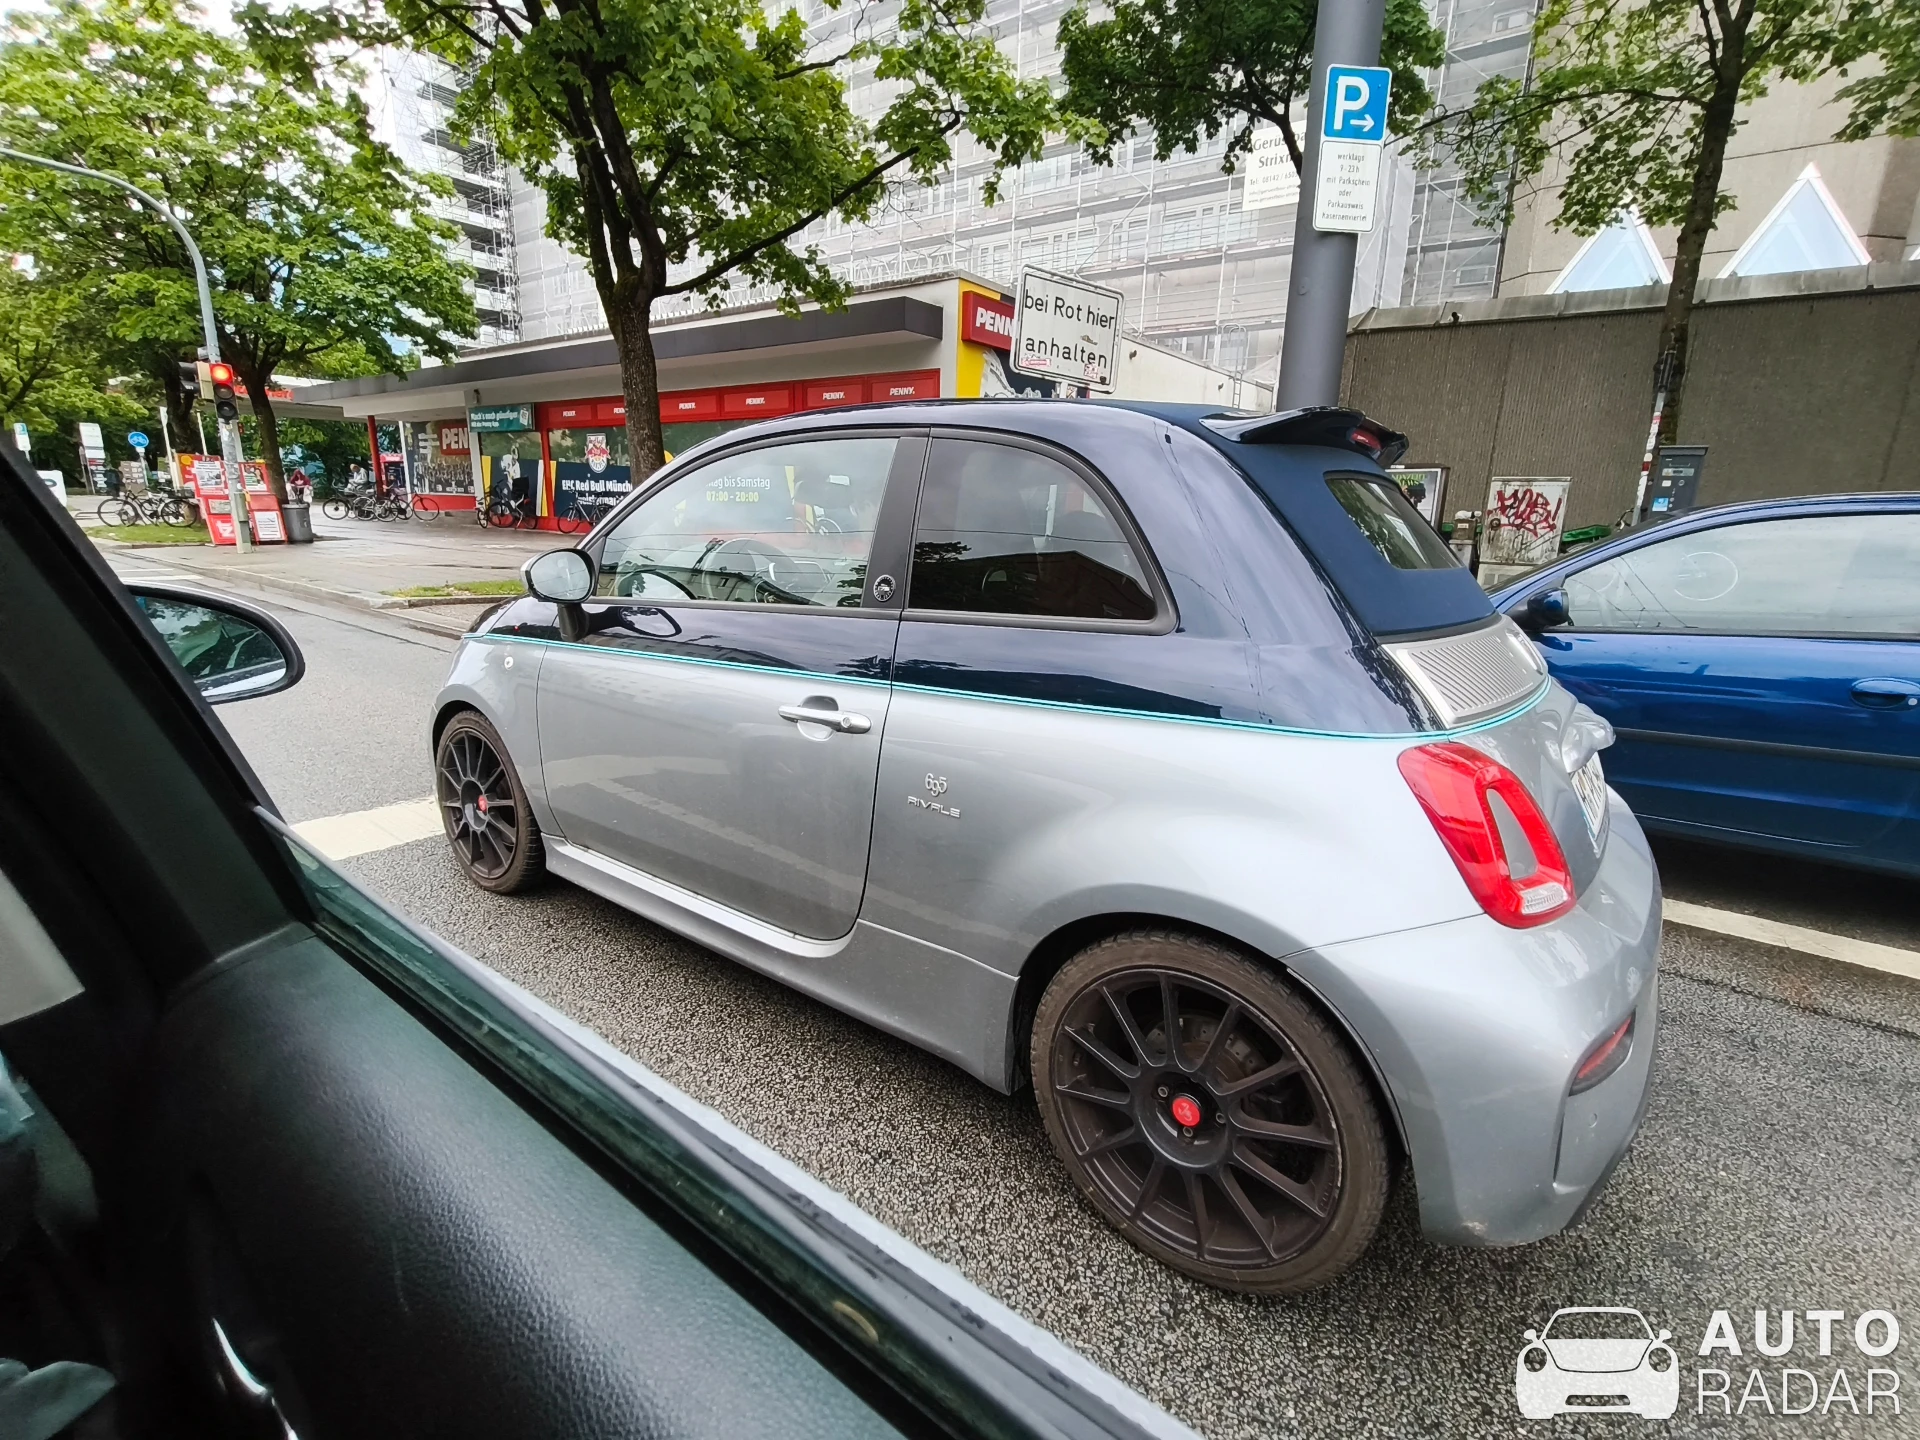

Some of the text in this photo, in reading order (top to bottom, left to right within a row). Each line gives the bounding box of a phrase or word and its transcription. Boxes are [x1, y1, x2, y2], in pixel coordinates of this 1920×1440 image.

[1334, 75, 1370, 130] P
[1337, 153, 1365, 163] werktags
[1338, 189, 1352, 197] oder
[1024, 289, 1115, 330] bei Rot hier
[1025, 337, 1107, 369] anhalten
[575, 479, 590, 492] Red
[590, 479, 606, 493] Bull
[724, 476, 736, 488] bis
[736, 476, 771, 490] Samstag
[706, 491, 729, 502] 07:00
[735, 491, 760, 502] 20:00
[925, 772, 948, 797] 695
